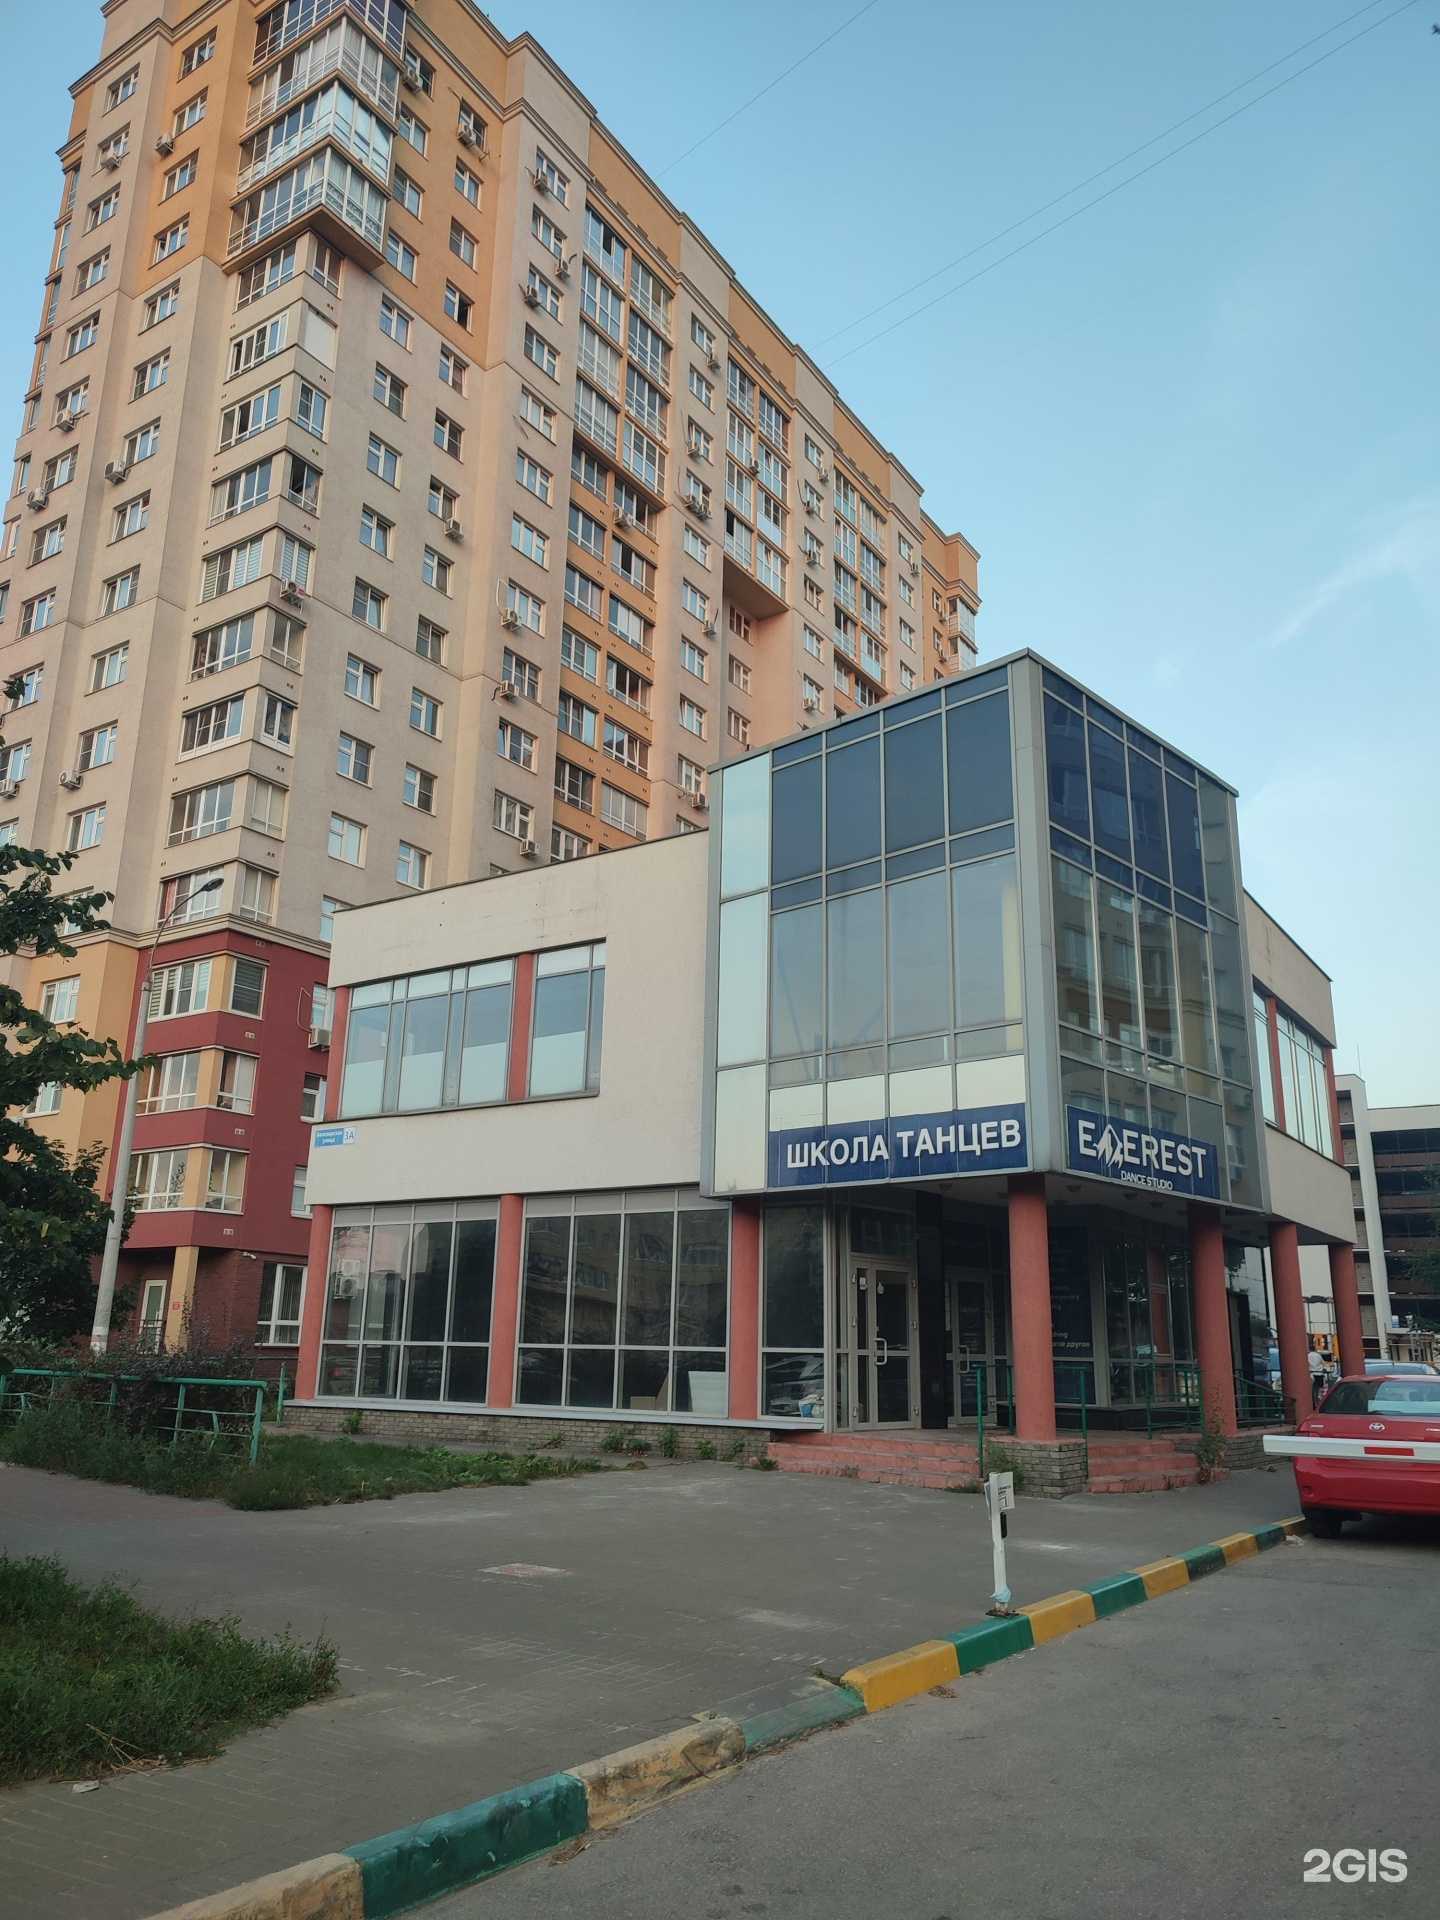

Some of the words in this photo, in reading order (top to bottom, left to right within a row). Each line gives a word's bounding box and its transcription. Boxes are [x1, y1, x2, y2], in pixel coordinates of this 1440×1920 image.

[787, 1134, 889, 1169] ШКОЛА
[896, 1119, 1021, 1158] ТАНЦЕВ
[1120, 1170, 1147, 1185] DANCE
[1147, 1176, 1174, 1191] STUDIO
